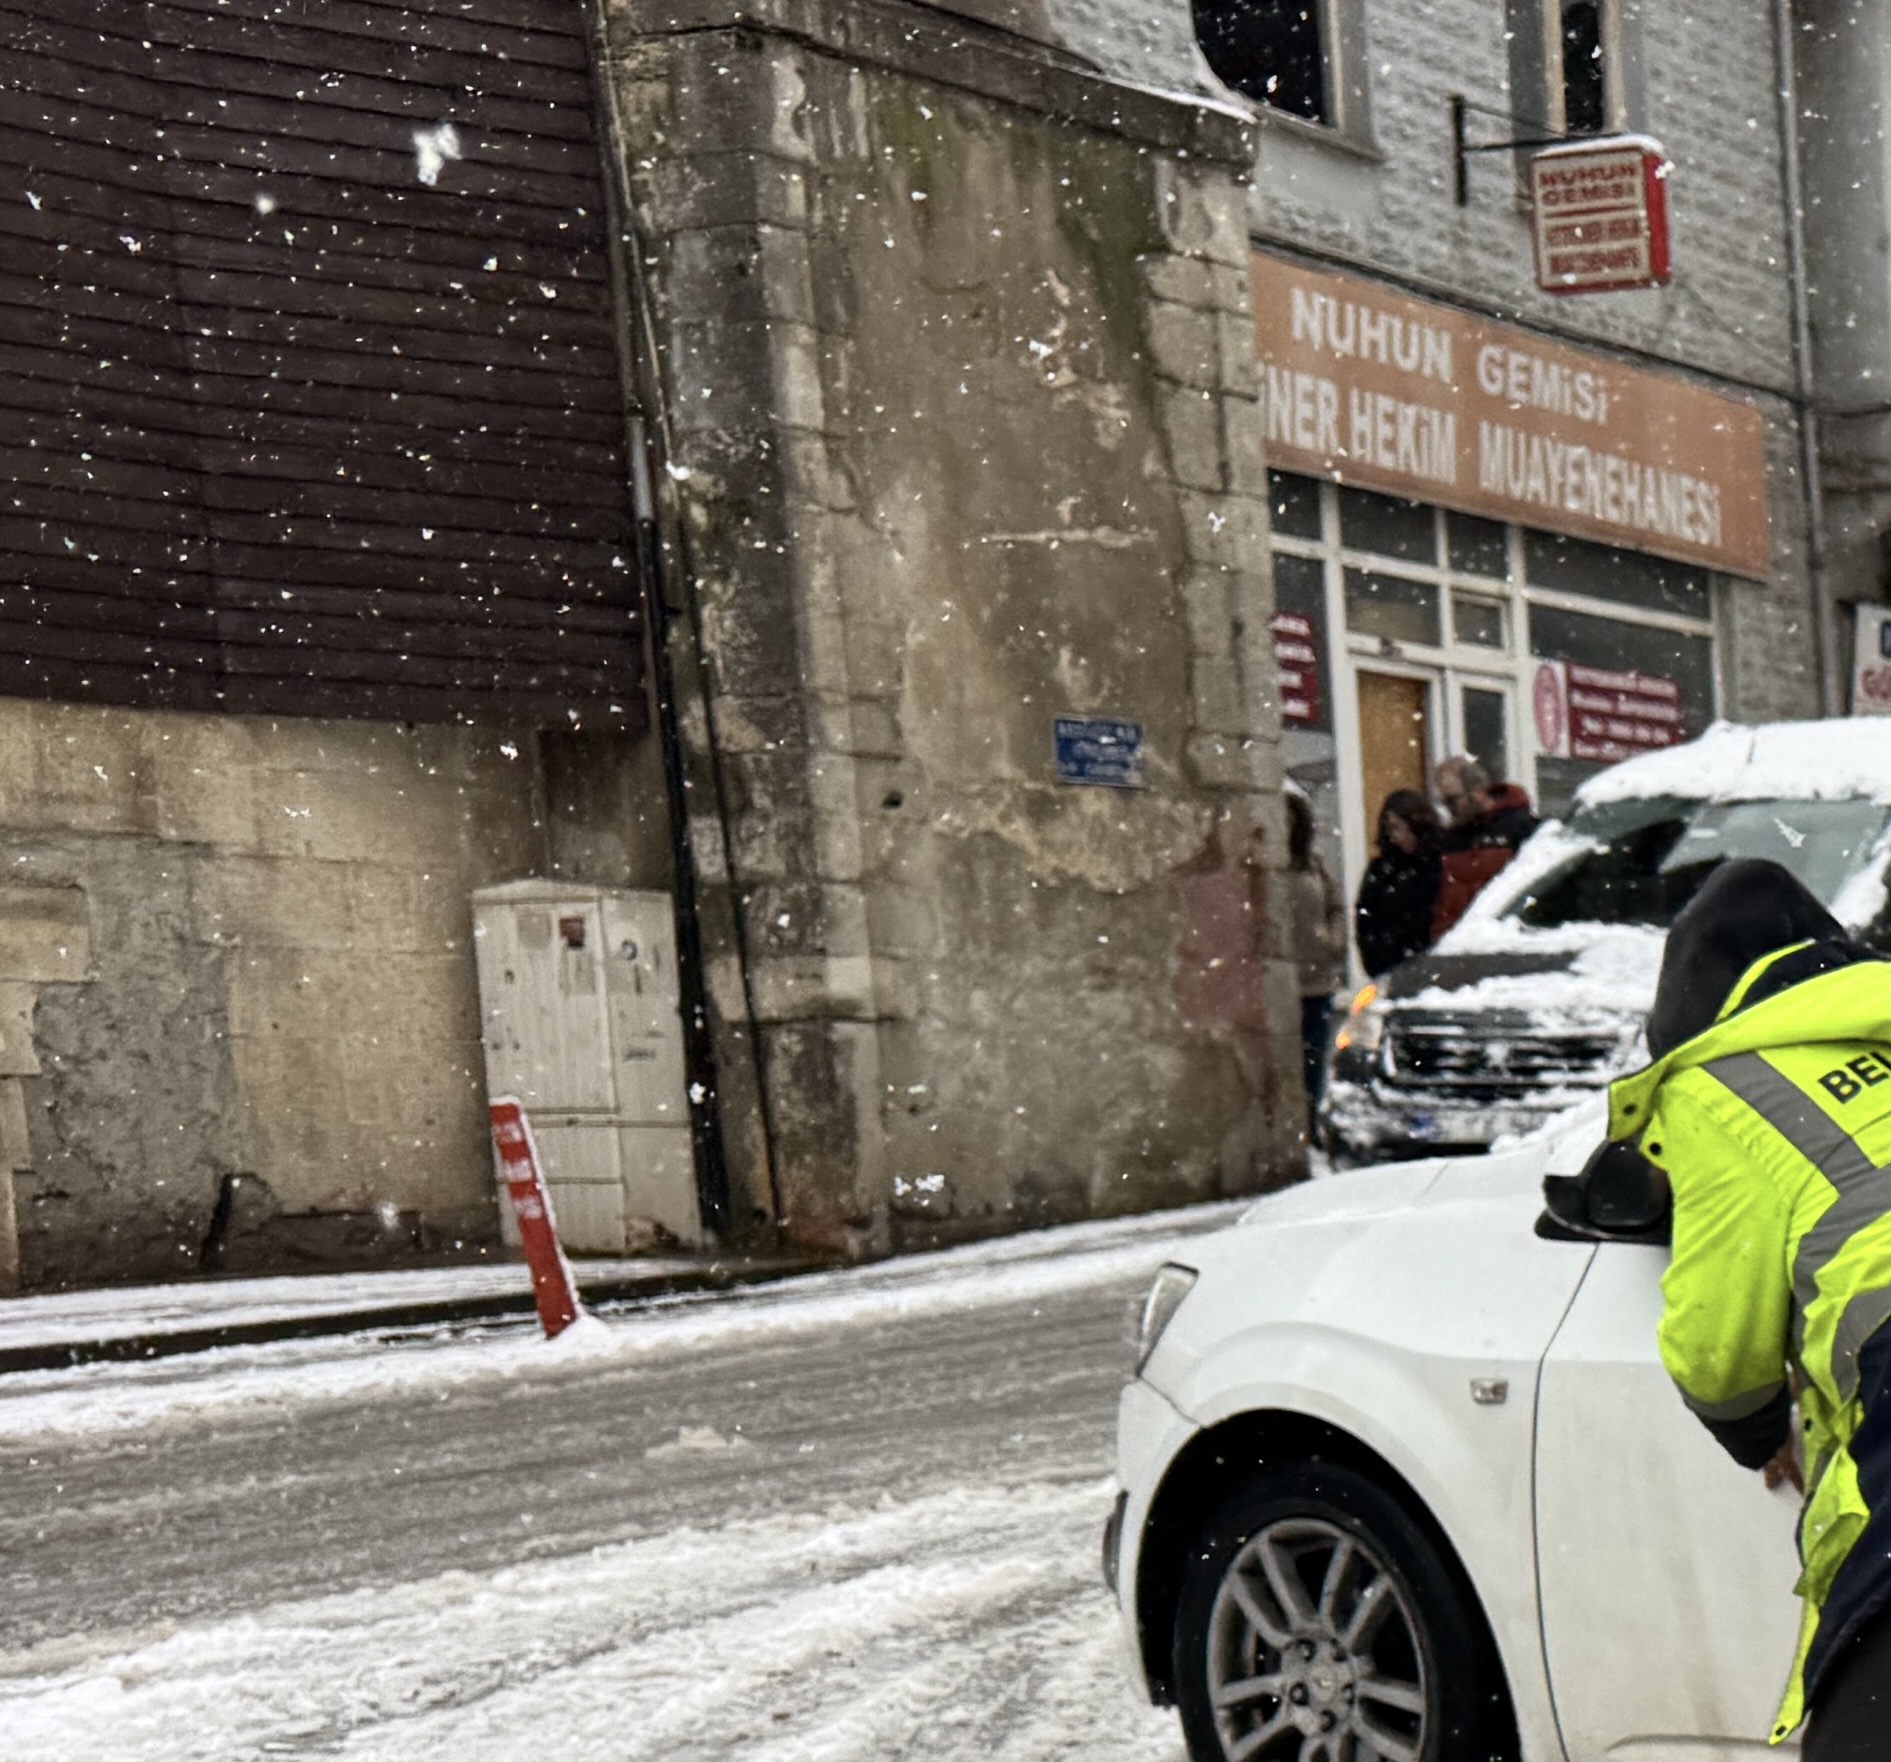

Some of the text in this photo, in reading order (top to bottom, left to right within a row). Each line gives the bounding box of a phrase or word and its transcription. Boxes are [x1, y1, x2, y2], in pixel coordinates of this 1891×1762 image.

[1291, 288, 1454, 383] NUHUN
[1260, 362, 1338, 456] NER
[1349, 386, 1457, 486] HEKİM
